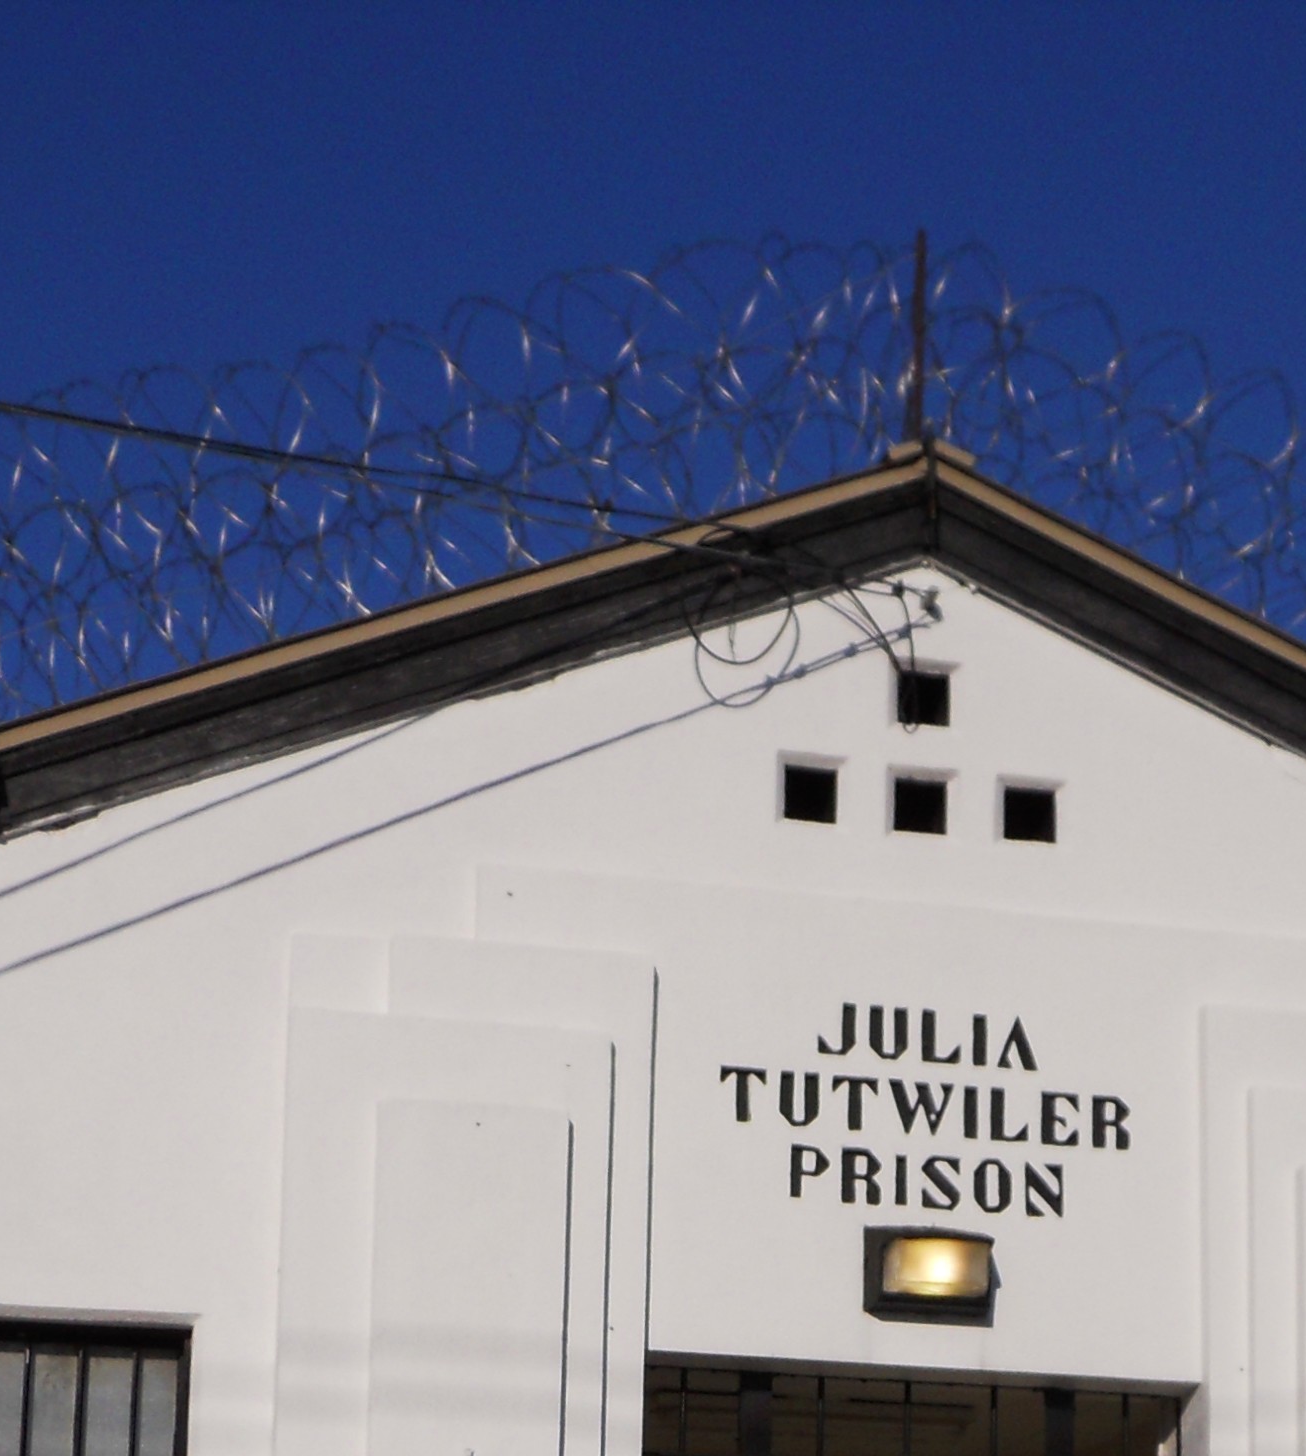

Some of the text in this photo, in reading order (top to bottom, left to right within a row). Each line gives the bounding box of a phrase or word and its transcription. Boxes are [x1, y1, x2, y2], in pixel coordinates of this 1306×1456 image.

[818, 1002, 1038, 1071] JULIA
[720, 1065, 1131, 1150] TUTWILER
[789, 1143, 1064, 1217] PRISON
